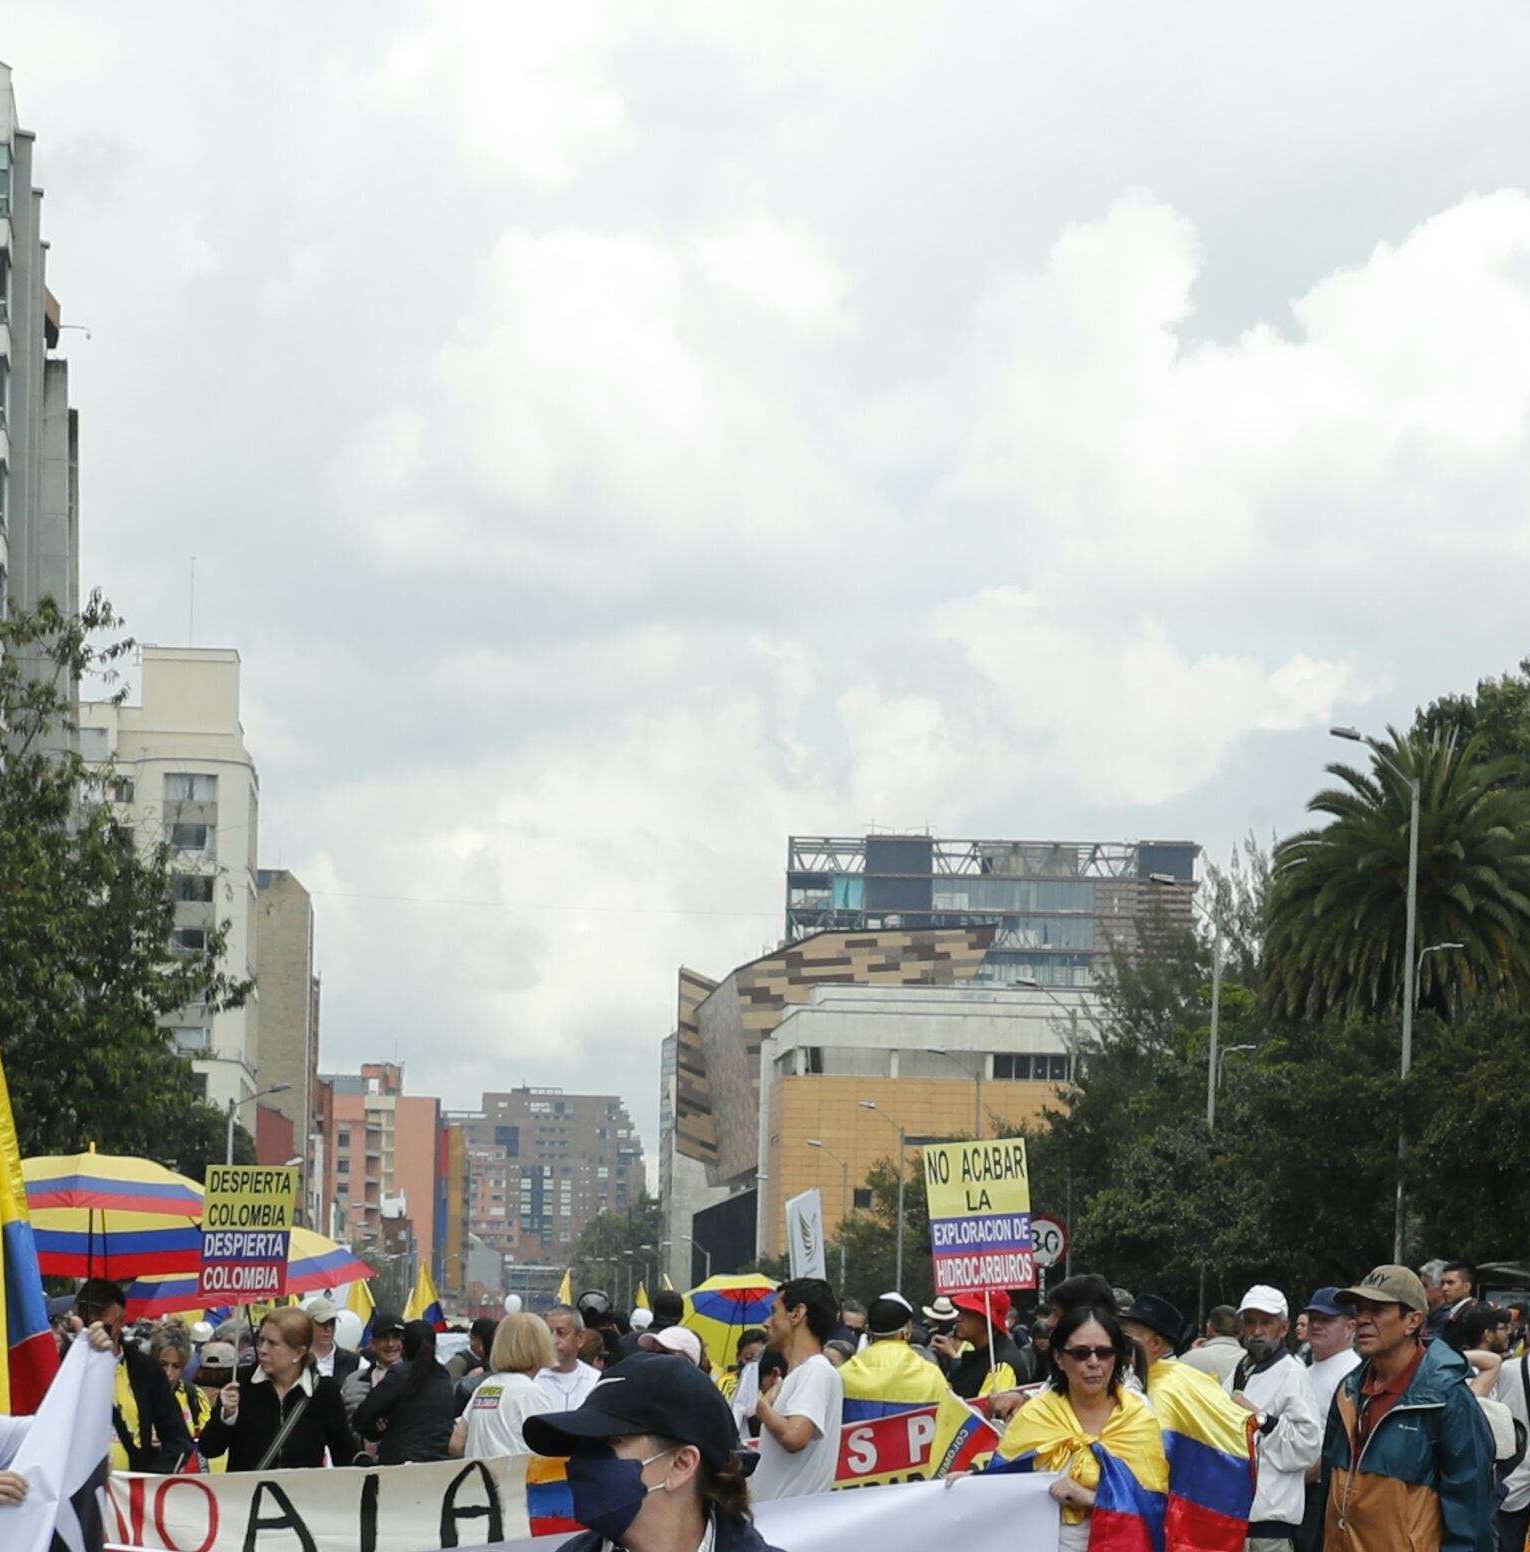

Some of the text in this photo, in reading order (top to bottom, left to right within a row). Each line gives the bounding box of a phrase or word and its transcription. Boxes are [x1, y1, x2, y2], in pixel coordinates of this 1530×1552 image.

[927, 1145, 1025, 1185] NO ACABAR
[210, 1170, 291, 1193] DESPIERTA
[965, 1189, 992, 1211] LA
[208, 1203, 285, 1226] COLOMBIA
[933, 1217, 1030, 1246] EXPLORACION DE
[204, 1232, 284, 1257] DESPIERTA
[202, 1266, 279, 1290] COLOMBIA
[936, 1252, 1033, 1288] HIDROCARBUROS
